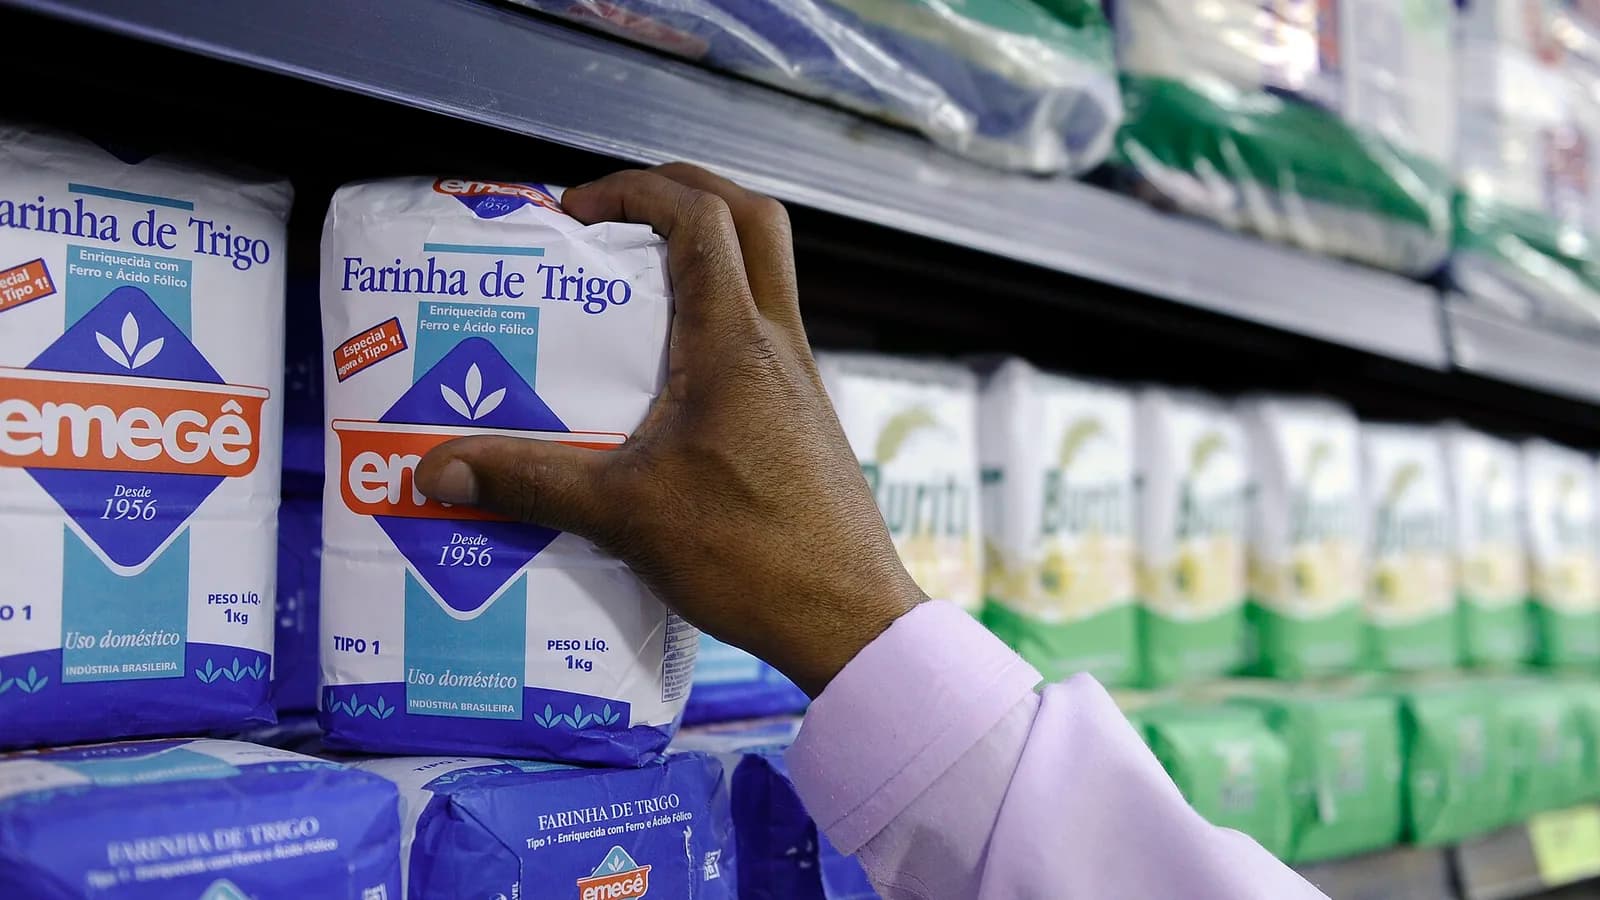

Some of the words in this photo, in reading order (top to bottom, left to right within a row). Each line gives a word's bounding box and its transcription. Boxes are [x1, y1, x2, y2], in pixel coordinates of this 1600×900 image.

[132, 209, 177, 250] de
[188, 216, 270, 271] Trigo
[79, 249, 151, 269] Enriquecida
[154, 260, 180, 273] com
[69, 264, 102, 278] Ferro
[105, 269, 113, 279] e
[116, 267, 150, 283] Ácido
[153, 272, 188, 289] Fólico
[341, 256, 468, 296] Farinha
[479, 259, 525, 298] de
[537, 262, 632, 315] Trigo
[2, 285, 33, 302] Tipo
[34, 276, 50, 290] 1!
[430, 305, 498, 320] Enriquecida
[501, 310, 526, 321] com
[420, 320, 451, 331] Ferro
[453, 323, 460, 332] e
[463, 319, 496, 333] Ácido
[499, 323, 535, 336] Fólico
[343, 327, 386, 358] Especial
[363, 343, 388, 360] Tipo
[389, 334, 402, 346] 1!
[114, 484, 152, 499] Desde
[100, 498, 157, 520] 1956
[450, 533, 489, 546] Desde
[438, 545, 493, 568] 1956
[208, 593, 238, 605] PESO
[241, 590, 261, 606] LÍQ.
[22, 605, 31, 620] 1
[224, 608, 249, 625] 1Kg
[65, 631, 95, 650] Uso
[100, 628, 181, 648] doméstico
[334, 636, 367, 653] TIPO
[371, 640, 380, 655] 1
[547, 639, 581, 651] PESO
[584, 637, 609, 652] LÍQ.
[65, 662, 120, 677] INDÚSTRIA
[122, 661, 178, 673] BRASILEIRA
[565, 655, 593, 672] 1Kg
[407, 668, 434, 686] Uso
[438, 669, 518, 690] doméstico
[409, 698, 458, 711] INDÚSTRIA
[460, 702, 515, 713] BRASILEIRA
[538, 807, 608, 831] FARINHA
[611, 804, 633, 819] DE
[635, 793, 680, 815] TRIGO
[247, 816, 320, 845] TRIGO
[526, 838, 545, 850] Tipo
[546, 836, 551, 845] 1
[558, 828, 606, 844] Enriquecida
[607, 825, 624, 835] com
[625, 821, 645, 832] Ferro
[647, 820, 652, 828] e
[652, 814, 672, 828] Ácido
[672, 810, 693, 823] Fólico
